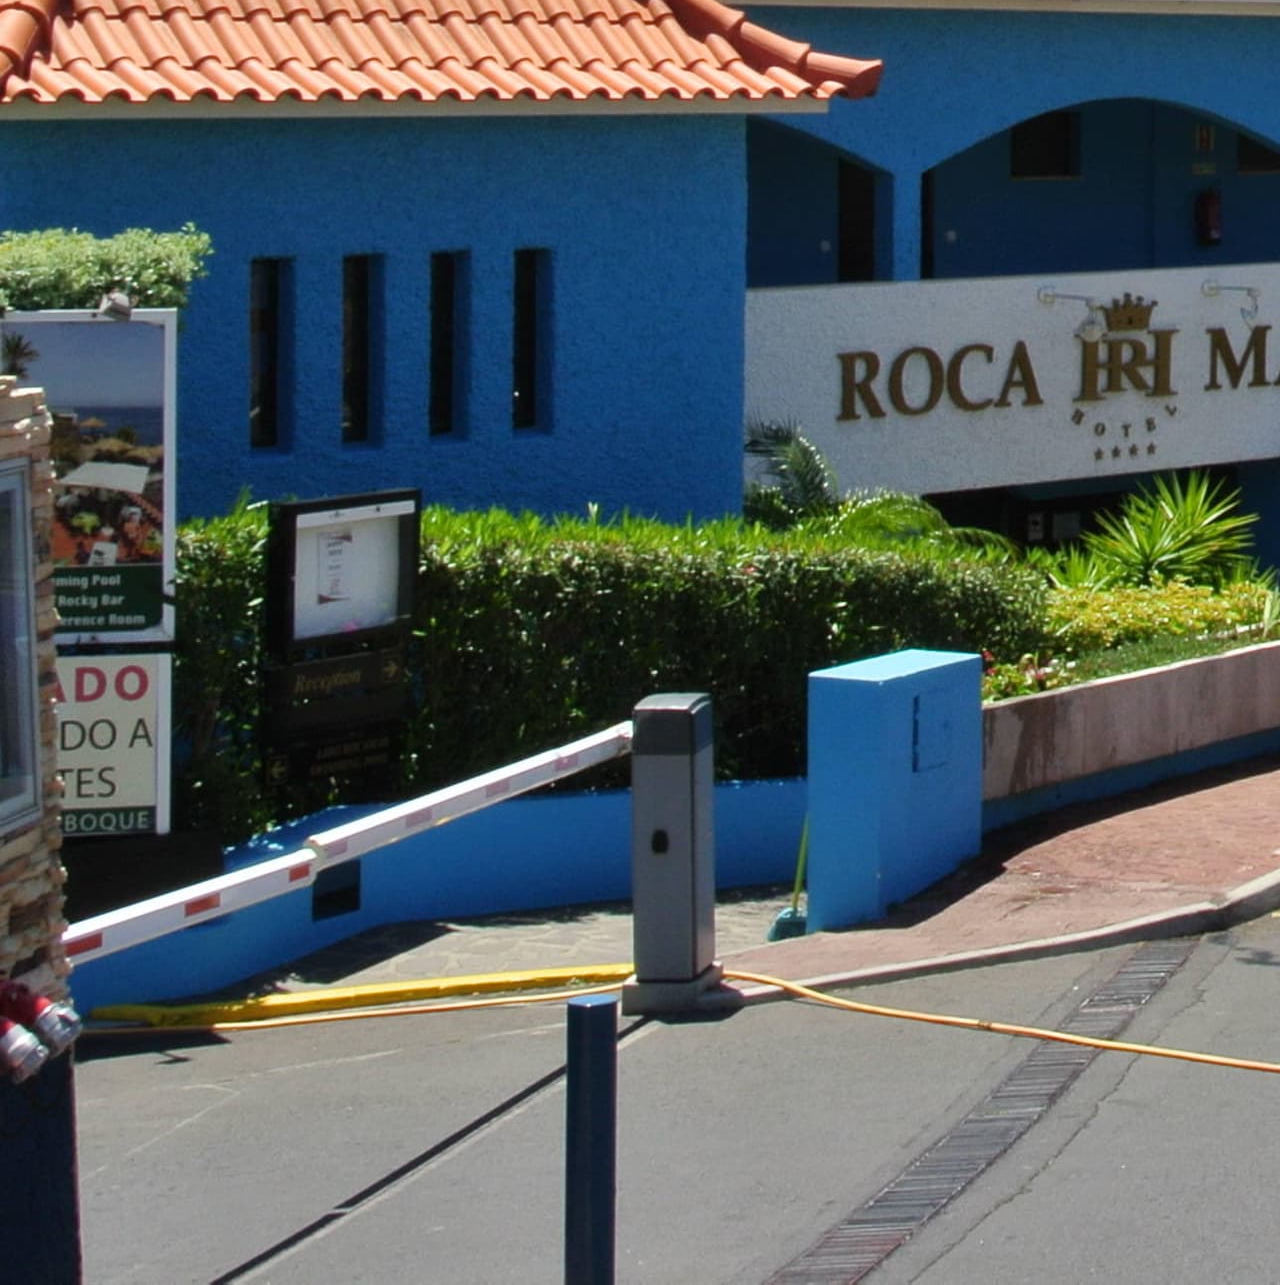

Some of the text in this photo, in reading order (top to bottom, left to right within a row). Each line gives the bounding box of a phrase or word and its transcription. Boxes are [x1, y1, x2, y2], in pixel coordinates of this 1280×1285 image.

[836, 340, 1044, 422] ROCA
[1071, 404, 1178, 439] HOTEL
[92, 574, 121, 586] Pool
[58, 594, 125, 609] Rocky Bar
[109, 614, 146, 625] Room
[128, 718, 153, 748] A
[64, 811, 149, 832] BOQUE
